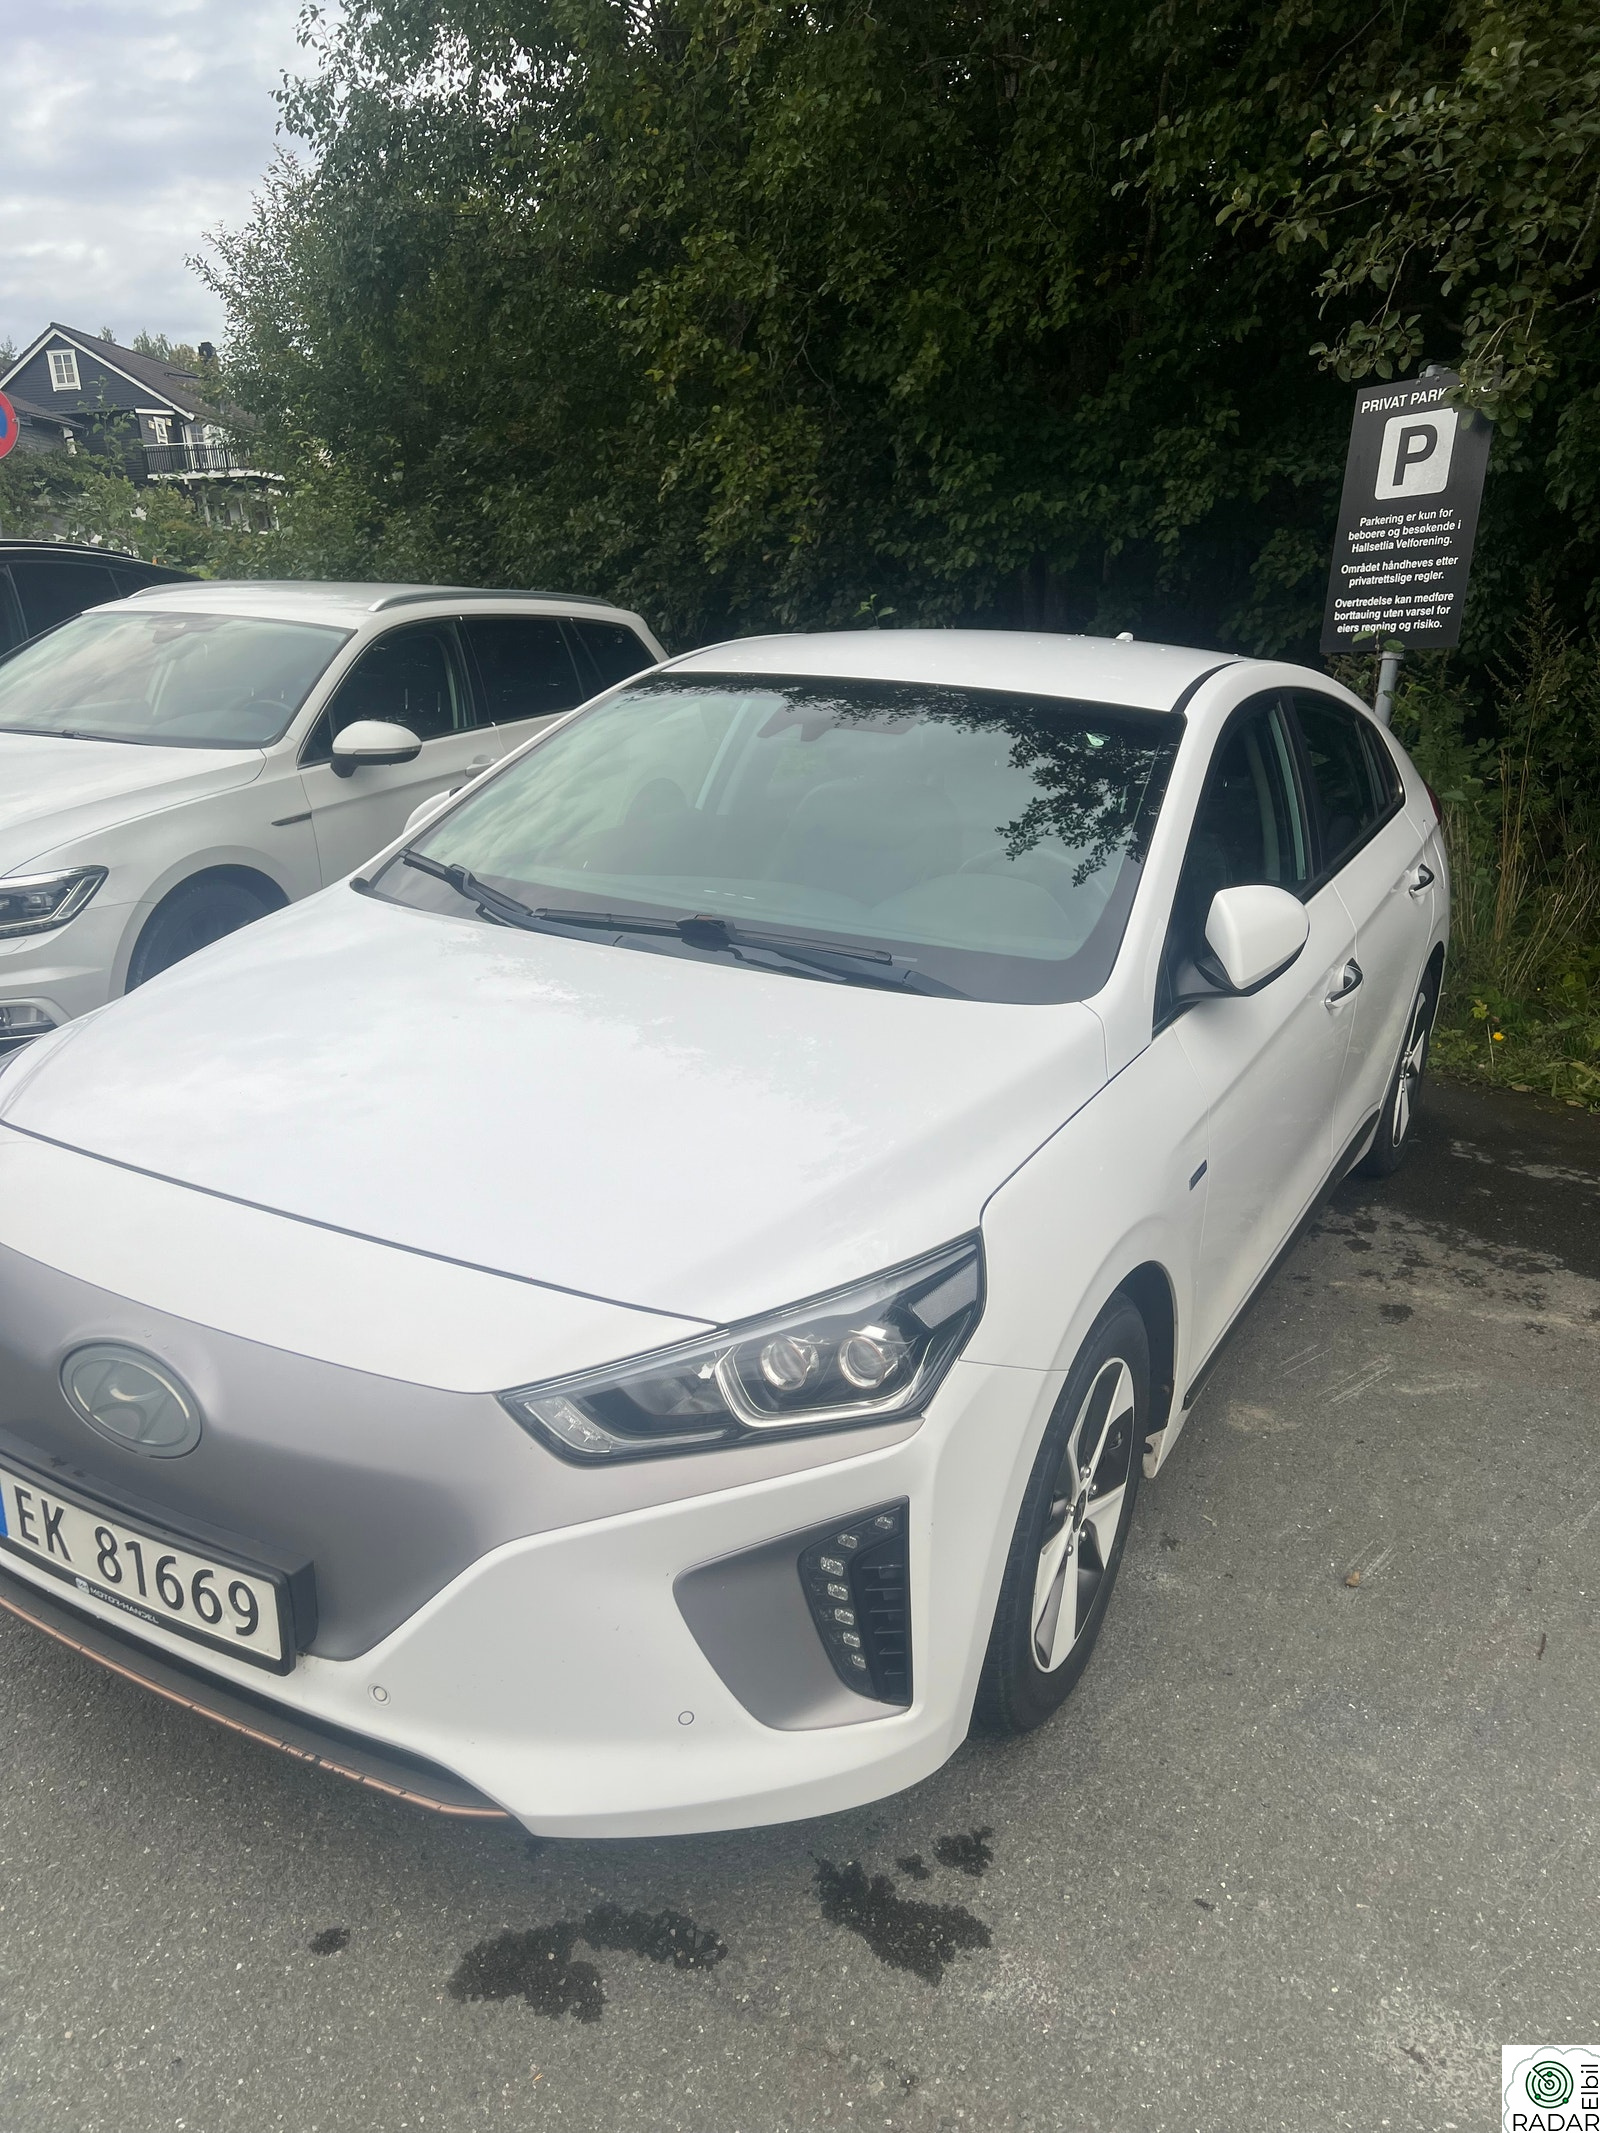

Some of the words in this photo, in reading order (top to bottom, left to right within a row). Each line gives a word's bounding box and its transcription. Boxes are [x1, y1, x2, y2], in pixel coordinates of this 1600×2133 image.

[1361, 394, 1408, 414] PRIVAT
[1392, 424, 1438, 486] P
[1359, 514, 1404, 527] Parkering
[1406, 513, 1417, 522] er
[1418, 510, 1437, 520] kun
[1439, 508, 1454, 518] for
[1348, 528, 1386, 541] beboere
[1388, 527, 1400, 538] og
[1402, 521, 1455, 535] besøkende
[1457, 520, 1462, 530] i
[1351, 540, 1394, 553] Hallsetlia
[1396, 535, 1453, 549] Velforening.
[1341, 561, 1380, 574] Området
[1382, 558, 1434, 571] håndheves
[1435, 556, 1459, 567] etter
[1348, 573, 1412, 588] privatrettslige
[1414, 570, 1445, 582] regler.
[1335, 595, 1392, 608] Overtredelse
[1394, 594, 1412, 605] kan
[1414, 591, 1454, 602] medføre
[1334, 608, 1381, 621] borttauing
[1383, 608, 1403, 618] uten
[1405, 605, 1435, 617] varsel
[1436, 605, 1451, 615] for
[1337, 623, 1359, 633] eiers
[1398, 621, 1411, 632] og
[1413, 618, 1443, 629] risiko.
[14, 1485, 72, 1562] EK
[94, 1525, 259, 1636] 81669
